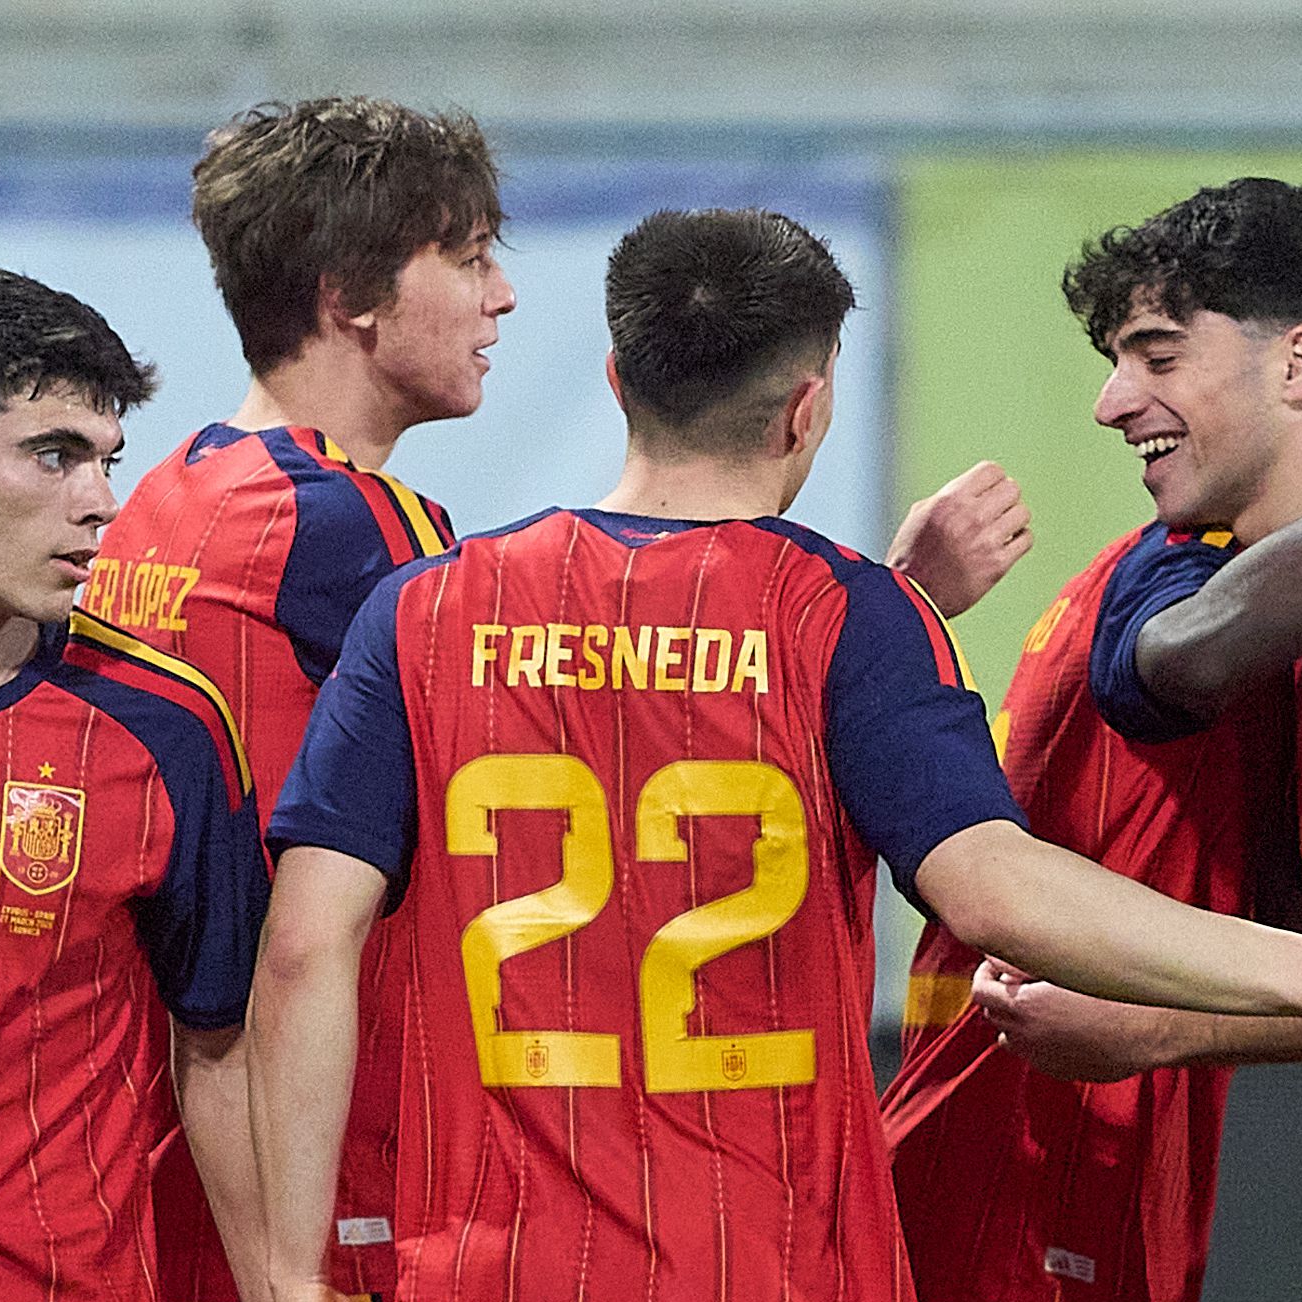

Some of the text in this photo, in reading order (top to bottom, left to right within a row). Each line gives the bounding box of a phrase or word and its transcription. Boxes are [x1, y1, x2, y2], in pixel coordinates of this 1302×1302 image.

[84, 546, 201, 631] ER LÓPEZ
[471, 622, 769, 694] FRESNEDA
[444, 753, 818, 1094] 22
